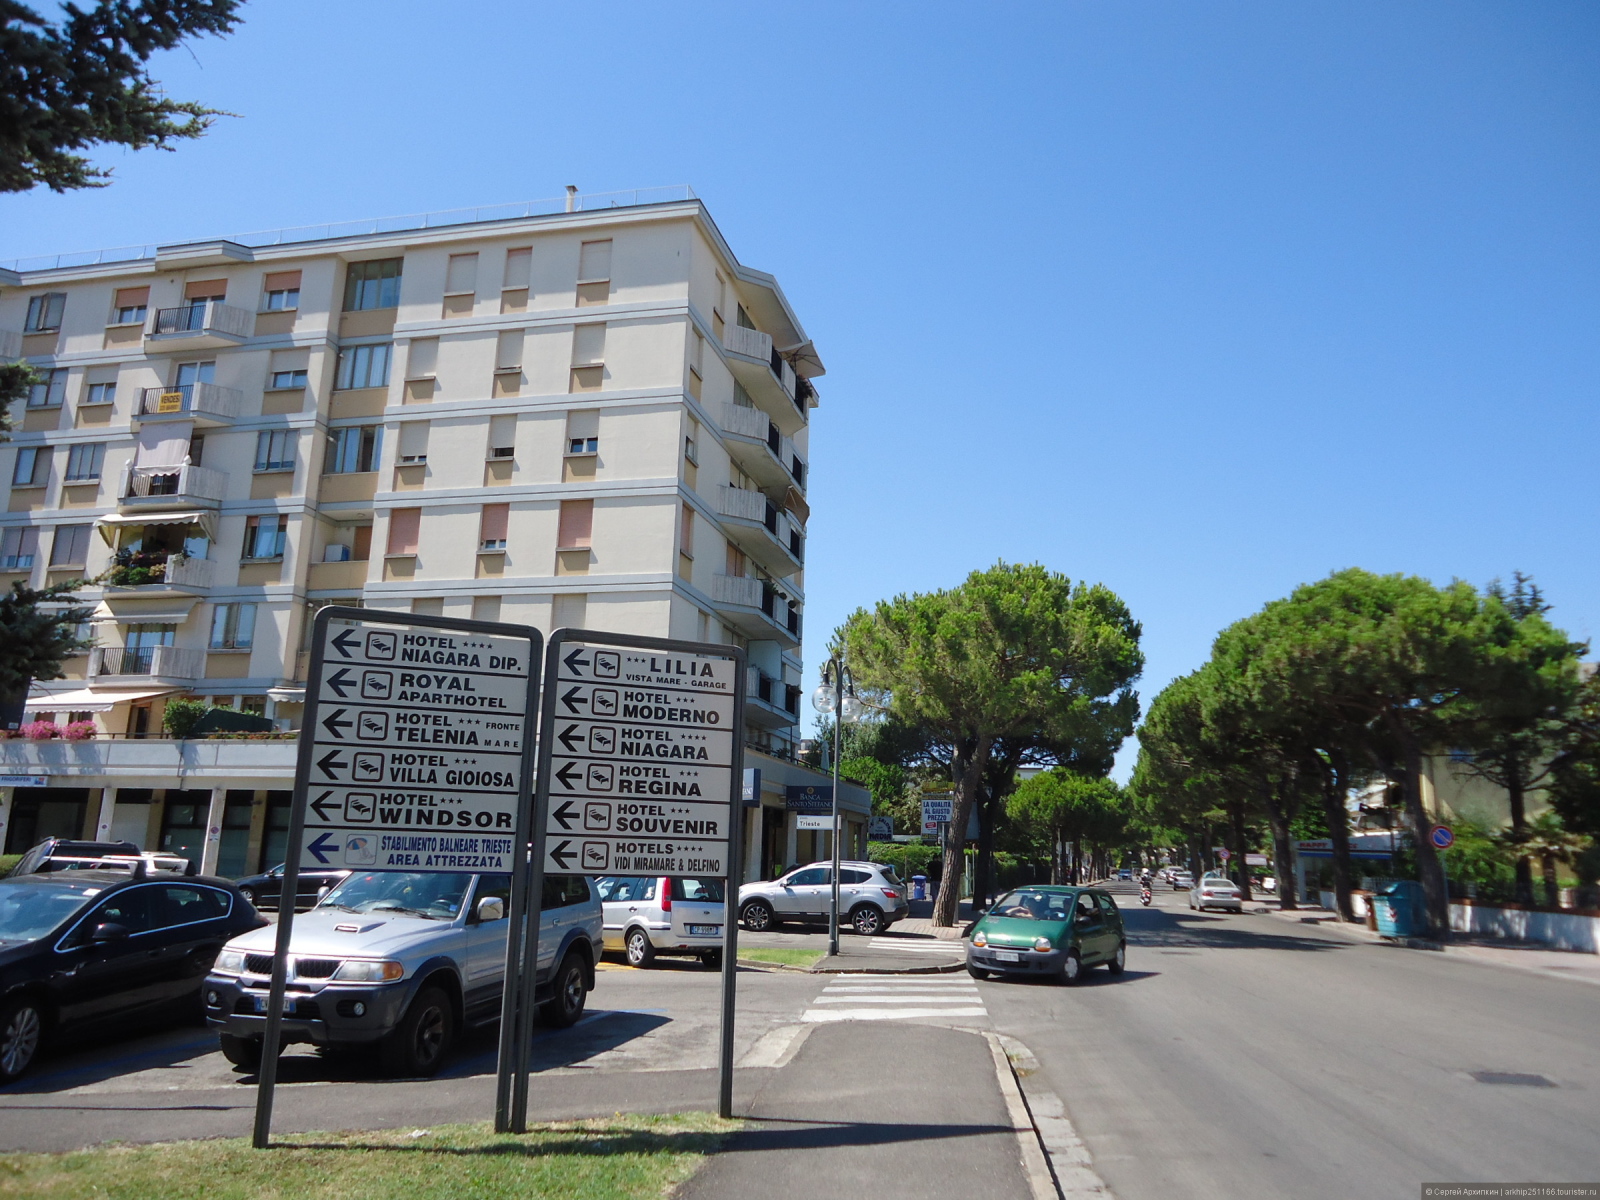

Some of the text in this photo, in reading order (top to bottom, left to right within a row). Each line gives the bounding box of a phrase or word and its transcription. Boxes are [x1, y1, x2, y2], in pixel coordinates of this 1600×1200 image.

[403, 635, 457, 649] HOTEL
[401, 648, 521, 671] NIAGARA DIP.
[650, 657, 714, 678] LILIA
[400, 673, 475, 692] ROYAL
[626, 674, 652, 683] VISTA
[656, 677, 681, 685] MARE
[691, 680, 727, 689] GARAGE
[398, 690, 507, 708] APARTHOTEL
[624, 691, 671, 705] HOTEL
[396, 713, 520, 731] HOTEL FRONTE
[622, 704, 720, 725] MODERNO
[394, 727, 519, 748] TELENIA MARE
[621, 728, 673, 742] HOTEL
[620, 741, 709, 761] NIAGARA
[391, 753, 448, 767] HOTEL
[390, 767, 514, 787] VILLA GIOIOSA
[619, 766, 670, 779] HOTEL
[618, 779, 702, 797] REGINA
[379, 793, 438, 807] HOTEL
[787, 800, 807, 808] SANTO
[800, 793, 821, 801] BANCA
[379, 807, 512, 828] WINDSOR
[617, 803, 666, 816] HOTEL
[615, 817, 718, 835] SOUVENIR
[381, 835, 511, 854] STABILIMENTO BALNEARE TRIESTE
[615, 842, 674, 855] HOTELS
[387, 853, 502, 868] AREA ATTREZZATA
[614, 856, 720, 872] VIDI MIRAMARE & DELFINO
